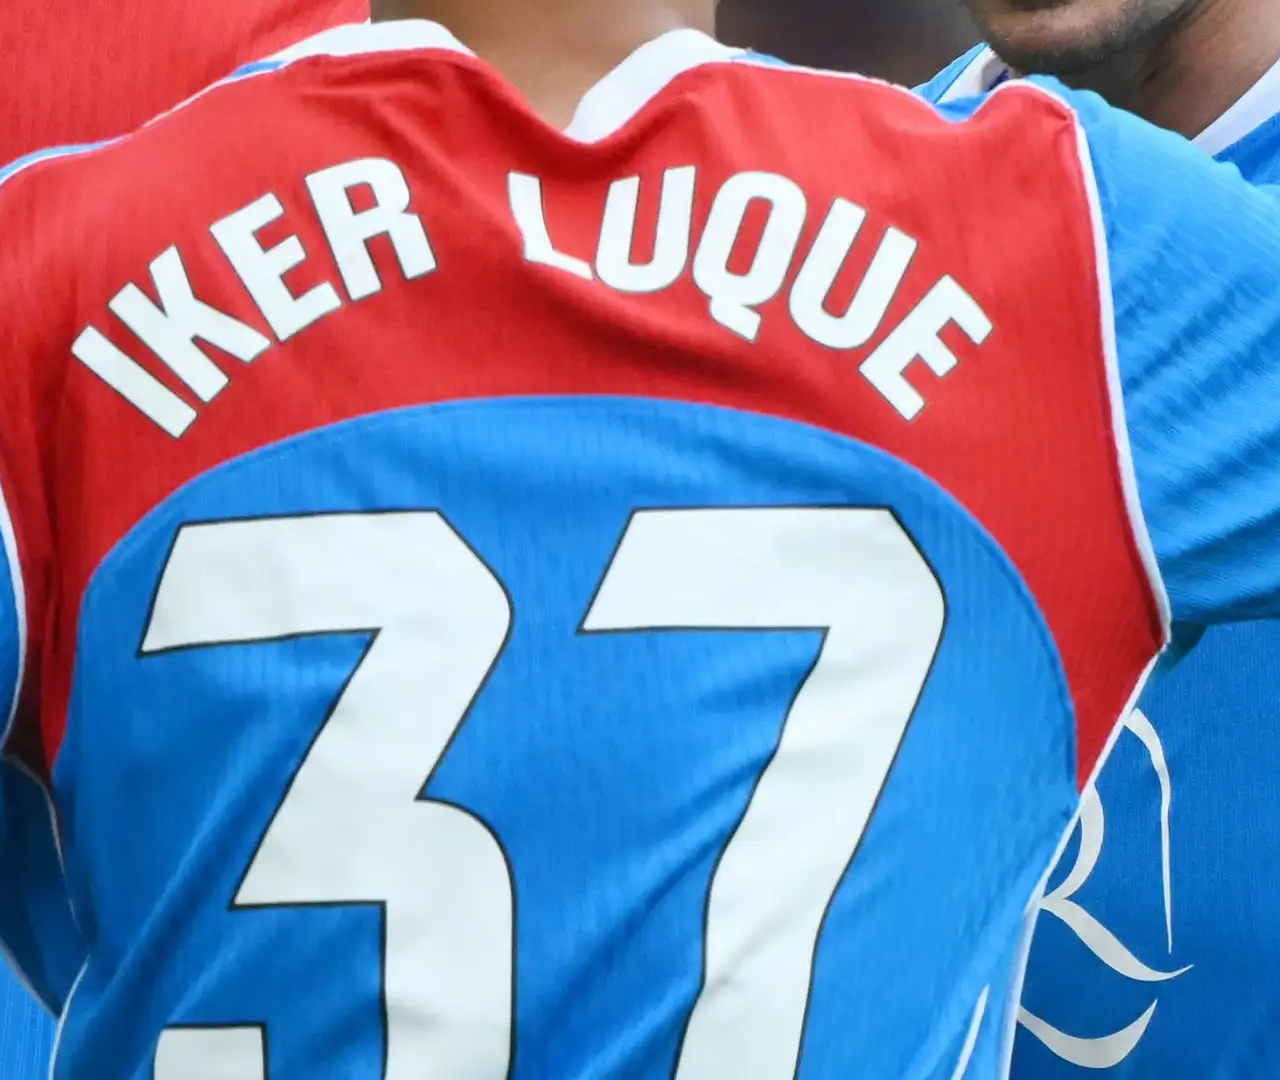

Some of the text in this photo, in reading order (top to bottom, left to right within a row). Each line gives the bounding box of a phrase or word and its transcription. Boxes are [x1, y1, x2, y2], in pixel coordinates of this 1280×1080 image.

[70, 156, 994, 440] IKER LUQUE
[136, 505, 946, 1080] 37
